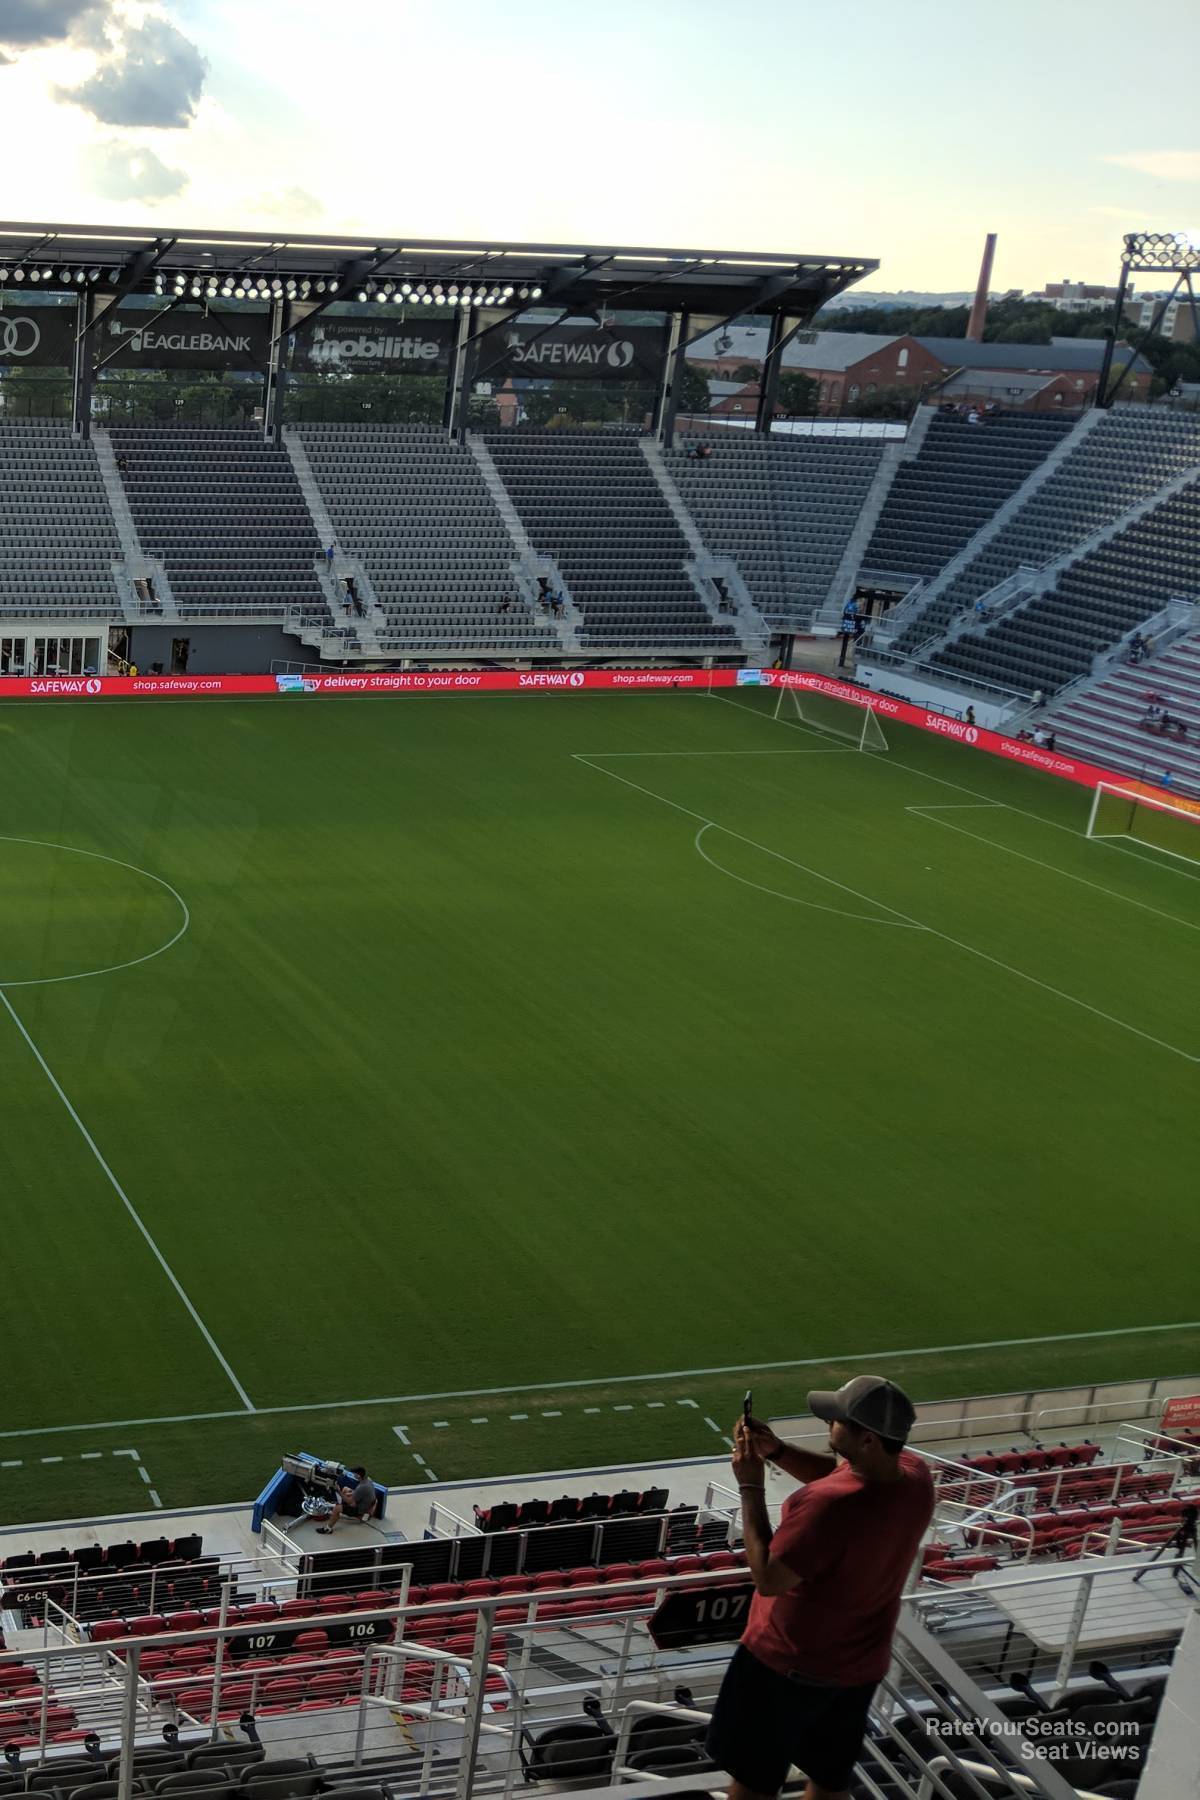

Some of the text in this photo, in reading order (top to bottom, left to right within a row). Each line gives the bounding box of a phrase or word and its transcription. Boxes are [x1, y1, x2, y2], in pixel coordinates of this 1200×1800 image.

[512, 342, 606, 364] SAFEWAY
[133, 680, 222, 692] shop.safeway.com
[324, 676, 369, 689] delivery
[370, 675, 411, 688] straight
[413, 675, 425, 686] to
[426, 676, 454, 688] your
[455, 674, 481, 686] door
[519, 674, 570, 686] SAFEWAY
[612, 673, 694, 685] shop.safeway.com
[30, 681, 85, 693] SAFEWAY
[779, 672, 824, 689] delivery
[822, 680, 852, 697] straight
[851, 689, 860, 701] to
[879, 699, 899, 713] door
[925, 714, 966, 738] SAFEWAY
[1001, 742, 1075, 773] shop.safeway.com
[16, 1591, 49, 1602] C6-C5
[695, 1594, 748, 1622] 107
[349, 1623, 376, 1638] 106
[248, 1635, 276, 1649] 107
